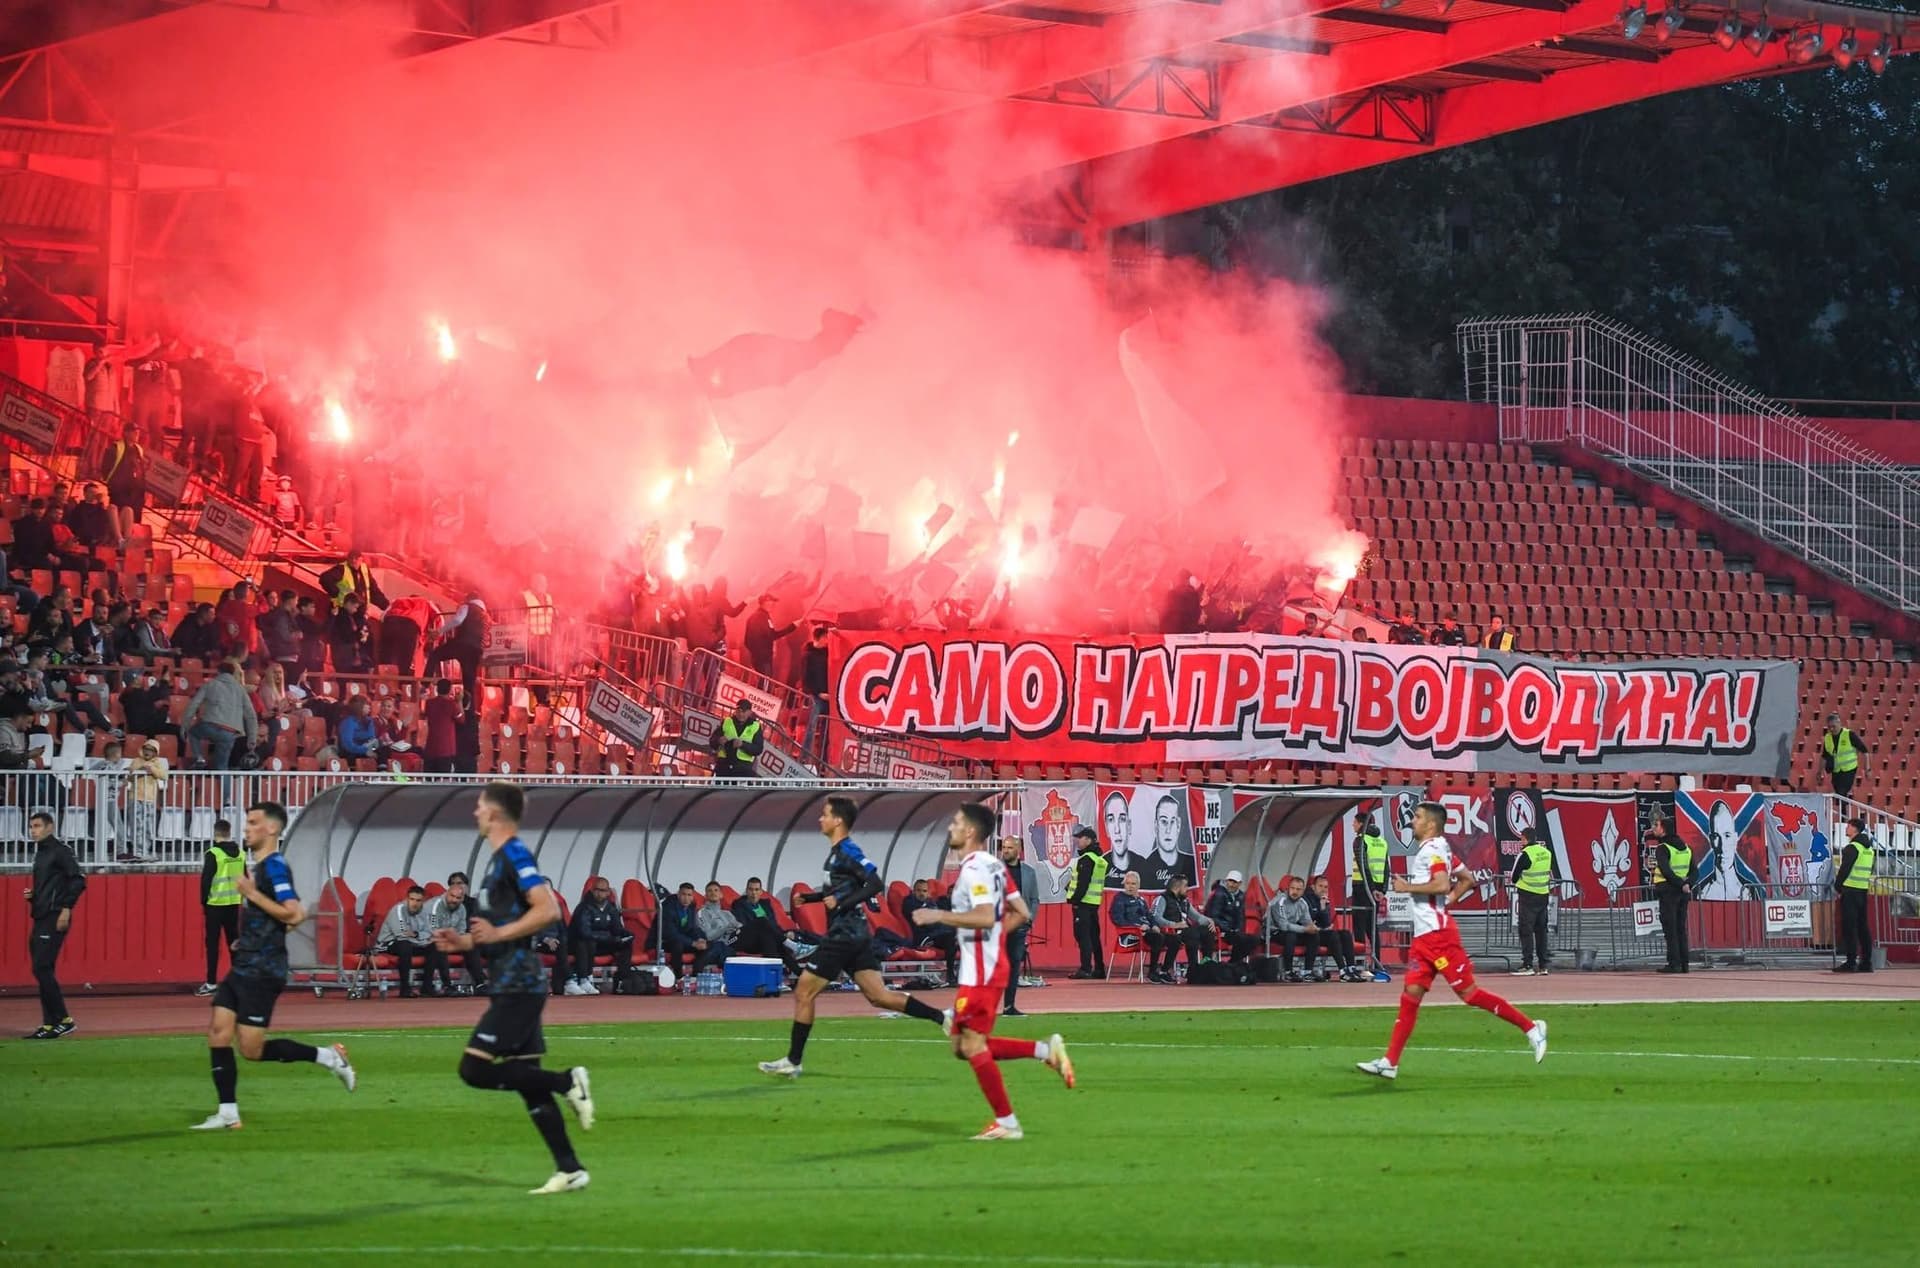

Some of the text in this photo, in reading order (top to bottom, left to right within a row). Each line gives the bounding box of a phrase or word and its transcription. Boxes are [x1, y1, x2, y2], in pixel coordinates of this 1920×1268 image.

[837, 641, 1765, 763] САМО НАПРЕД ВОЈВОДИНА!
[1207, 802, 1220, 819] НЕ
